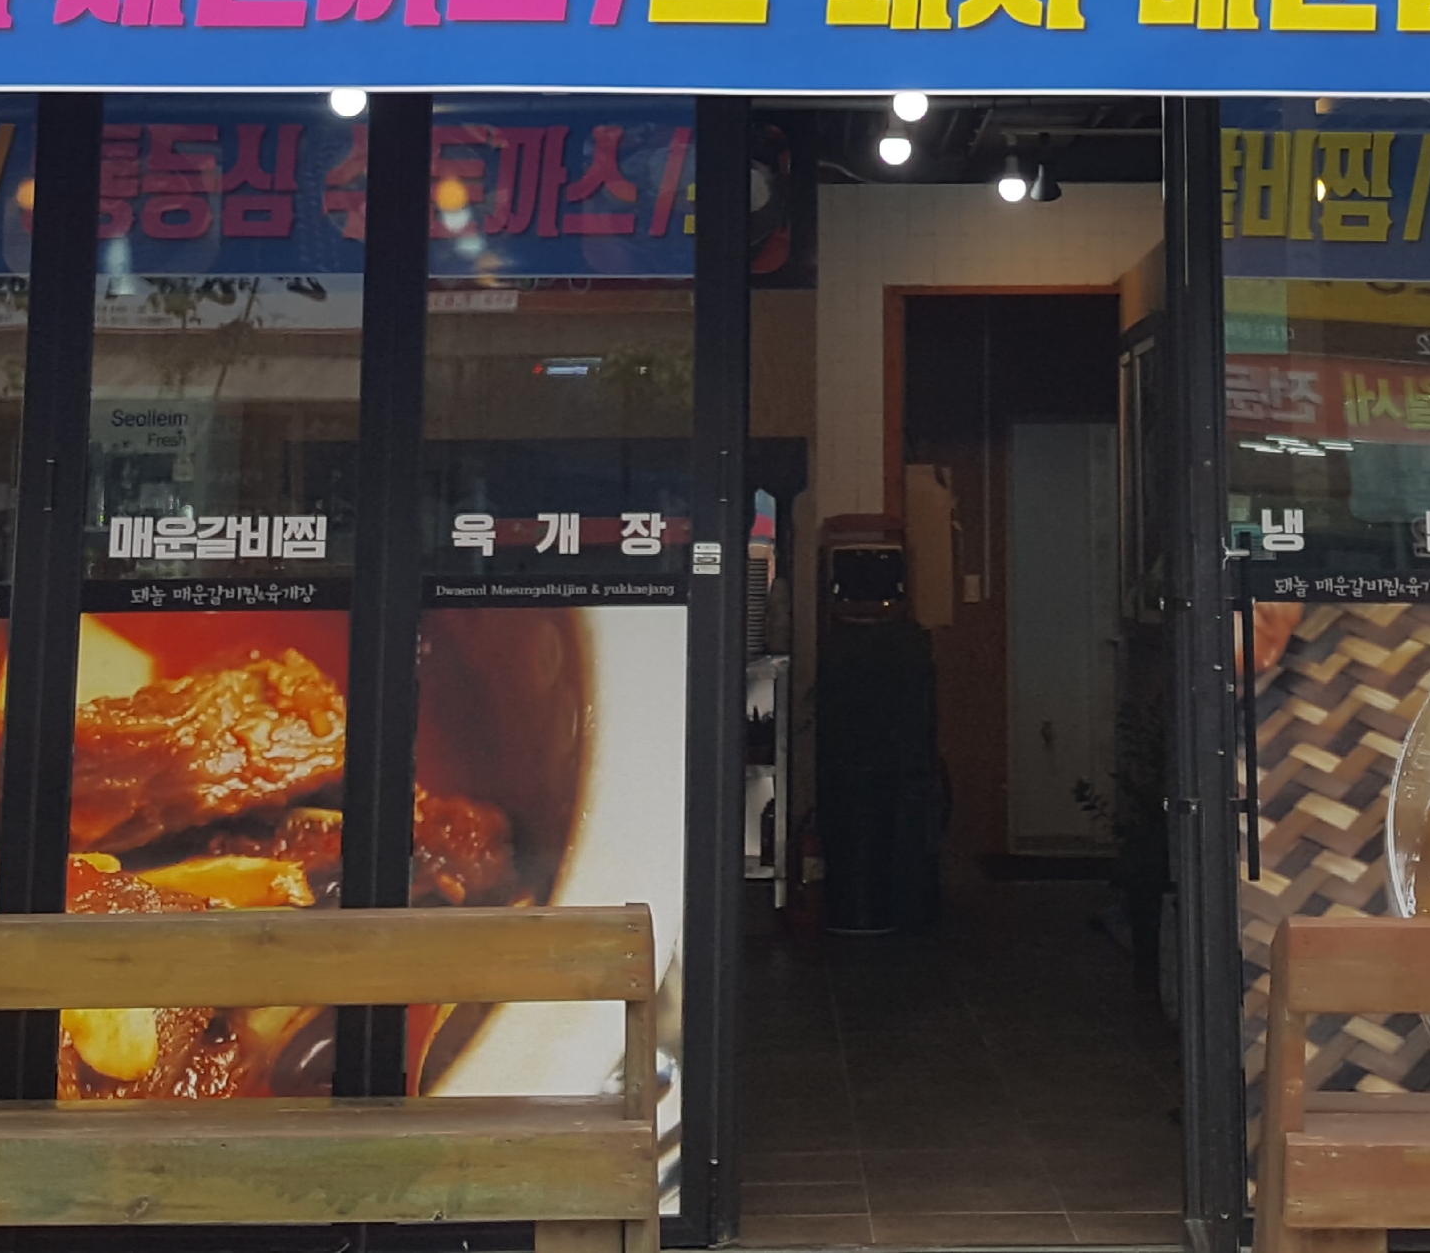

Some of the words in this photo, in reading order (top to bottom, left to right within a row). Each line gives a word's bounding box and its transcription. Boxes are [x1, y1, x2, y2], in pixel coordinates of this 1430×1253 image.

[108, 516, 327, 561] 매운갈비찜
[130, 584, 167, 606] 돼놀
[591, 583, 601, 595] &
[1274, 576, 1310, 597] 돼놀
